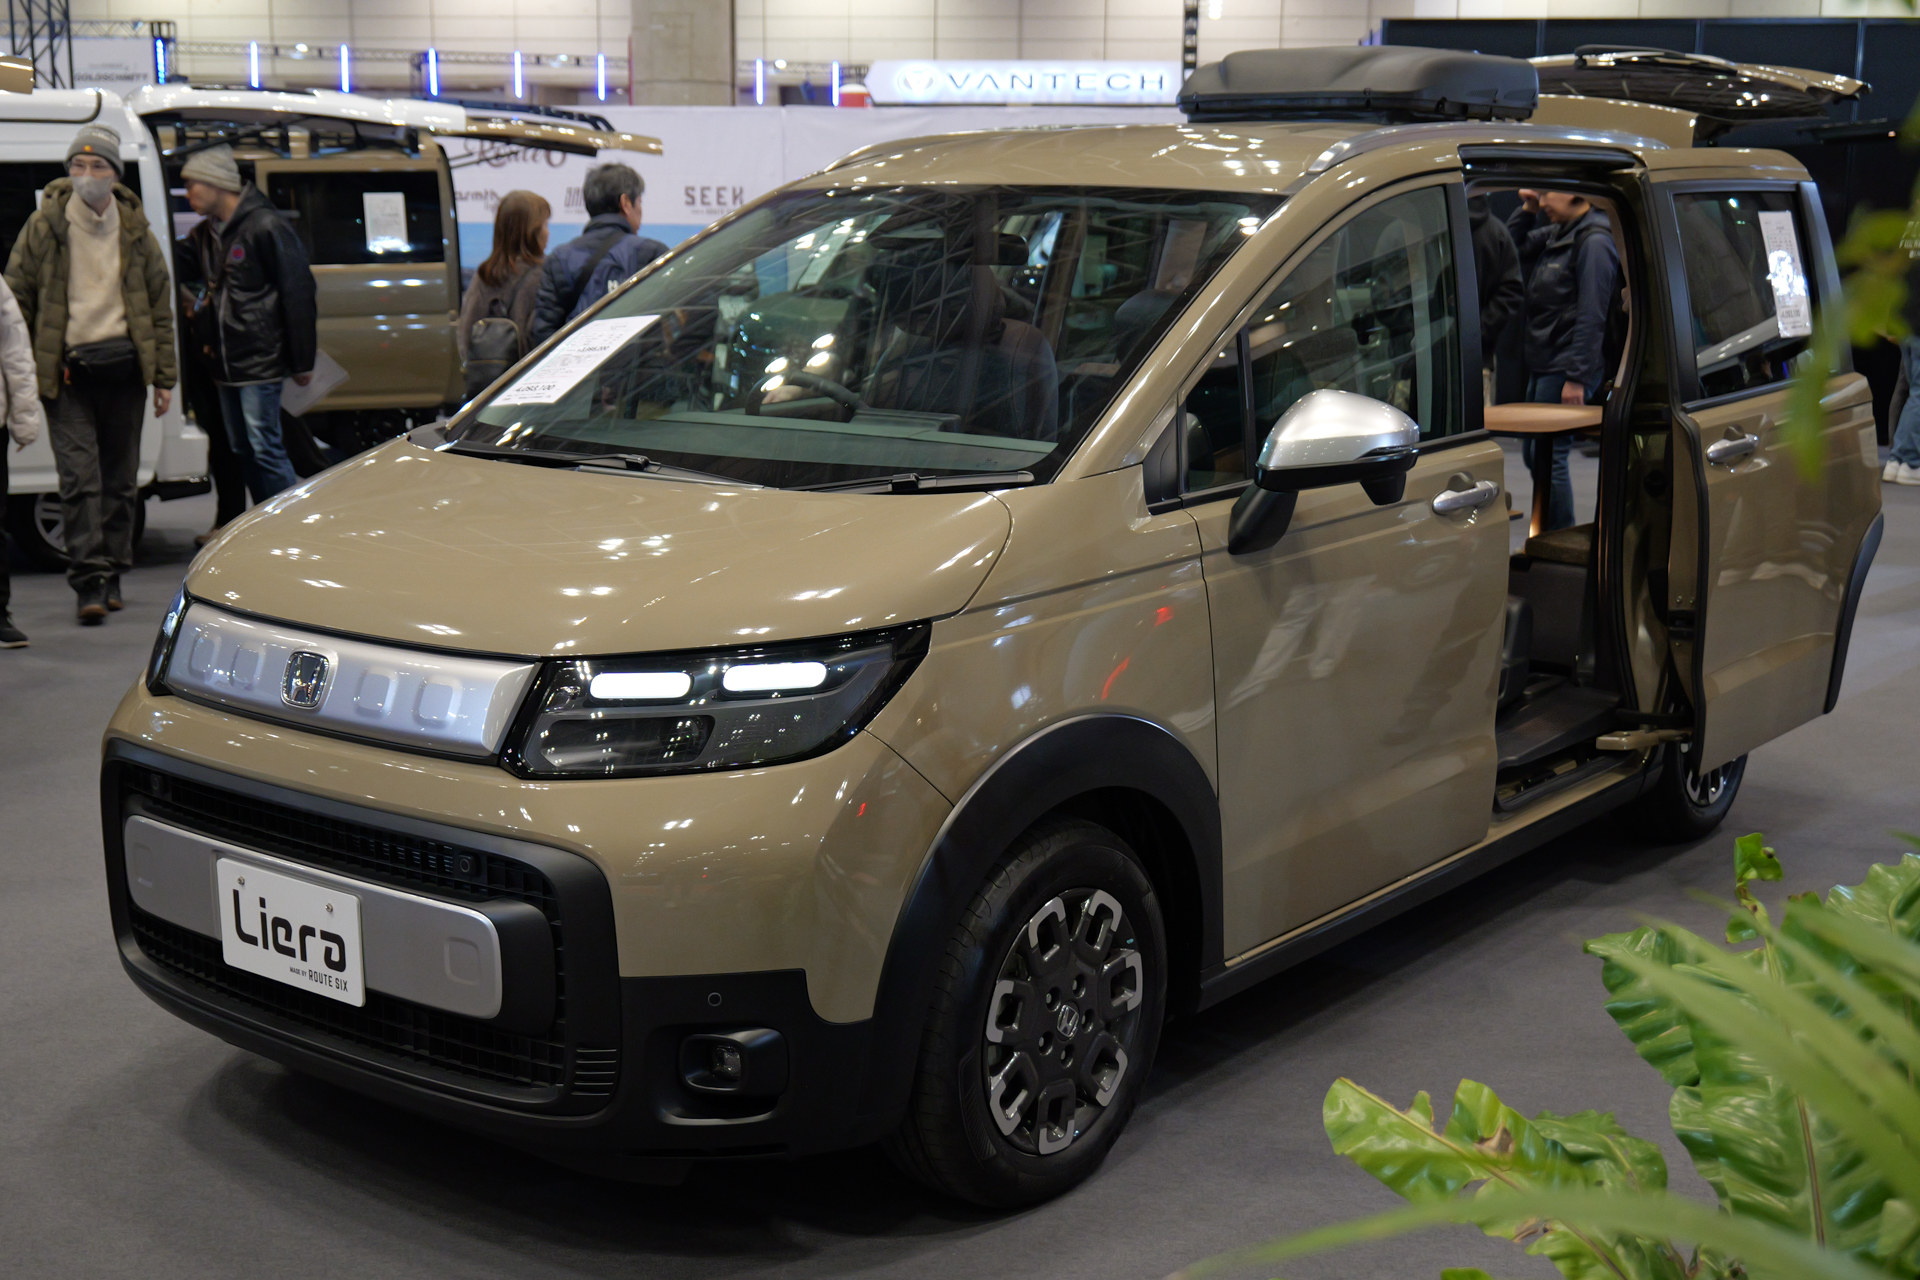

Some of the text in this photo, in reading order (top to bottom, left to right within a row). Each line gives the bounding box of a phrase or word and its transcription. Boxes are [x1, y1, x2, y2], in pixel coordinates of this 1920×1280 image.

[947, 72, 1164, 91] VANTECH
[290, 966, 301, 975] MADE
[309, 969, 333, 988] ROUTE
[335, 977, 348, 992] SIX
